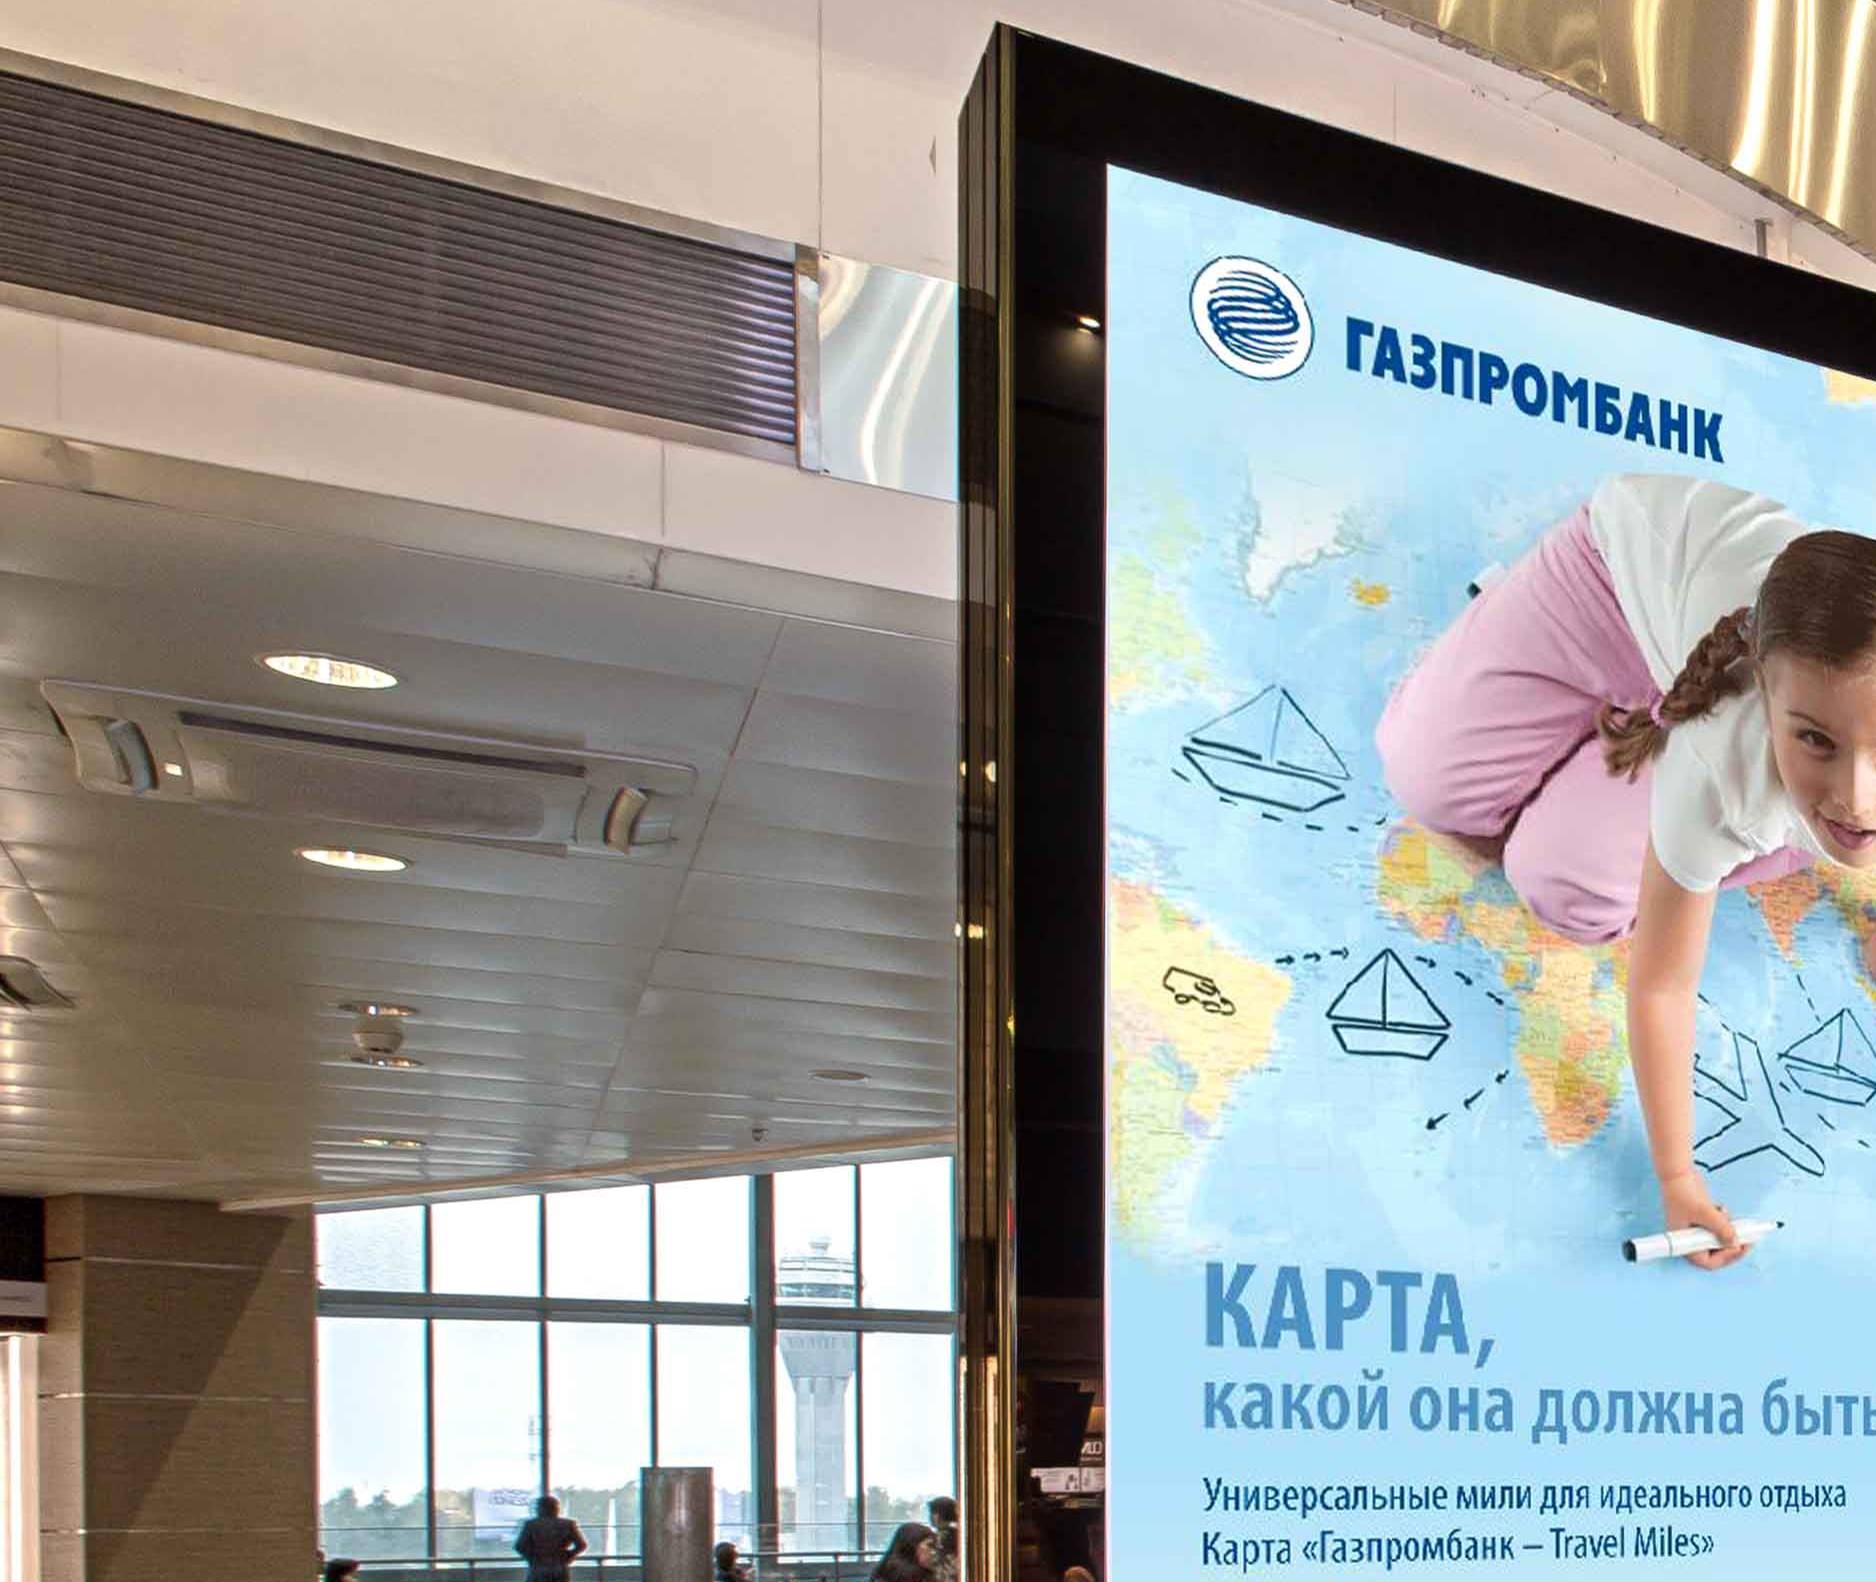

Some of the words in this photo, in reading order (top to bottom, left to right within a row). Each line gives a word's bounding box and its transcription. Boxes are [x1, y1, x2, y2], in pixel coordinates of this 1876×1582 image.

[1345, 316, 1725, 464] ГАЗПРОМБАНК
[1204, 1261, 1495, 1368] КАРТА,
[1204, 1368, 1388, 1431] какой
[1409, 1385, 1514, 1433] она
[1531, 1385, 1744, 1445] должна
[1203, 1477, 1448, 1518] Универсальные
[1455, 1482, 1532, 1510] мили
[1540, 1482, 1591, 1515] для
[1600, 1480, 1753, 1513] идеального
[1759, 1481, 1847, 1513] отдыха
[1202, 1530, 1292, 1573] Карта
[1302, 1527, 1514, 1569] «Газпромбанк
[1550, 1526, 1625, 1560] Travel
[1634, 1525, 1715, 1559] Miles»
